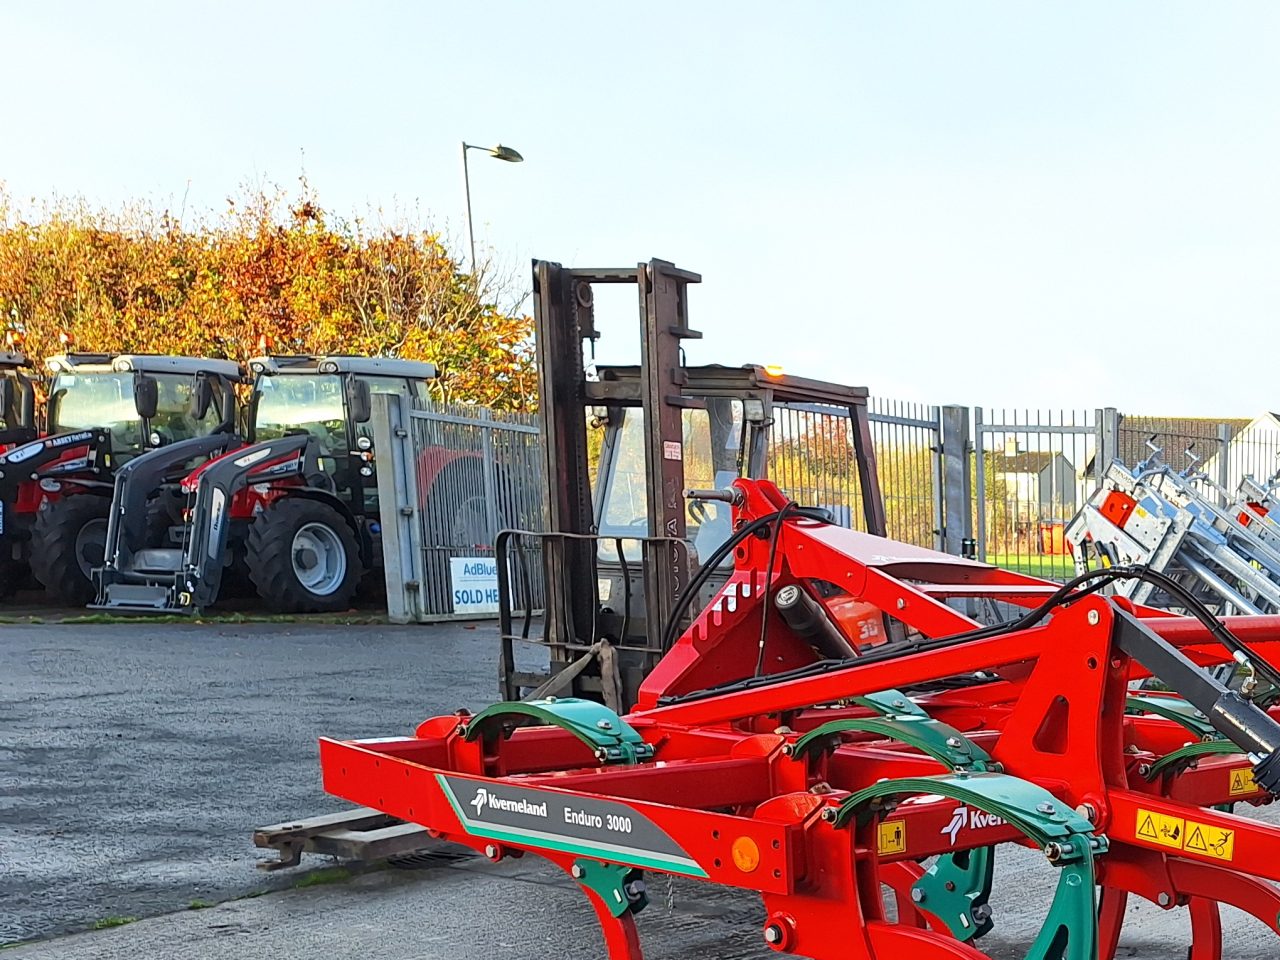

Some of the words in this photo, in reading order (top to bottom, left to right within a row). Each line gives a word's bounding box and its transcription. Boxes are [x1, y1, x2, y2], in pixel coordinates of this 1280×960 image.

[463, 562, 497, 576] AdBlue
[455, 589, 483, 605] SOLD
[488, 793, 548, 817] Kverneland
[564, 807, 603, 828] Enduro
[606, 814, 632, 834] 3000
